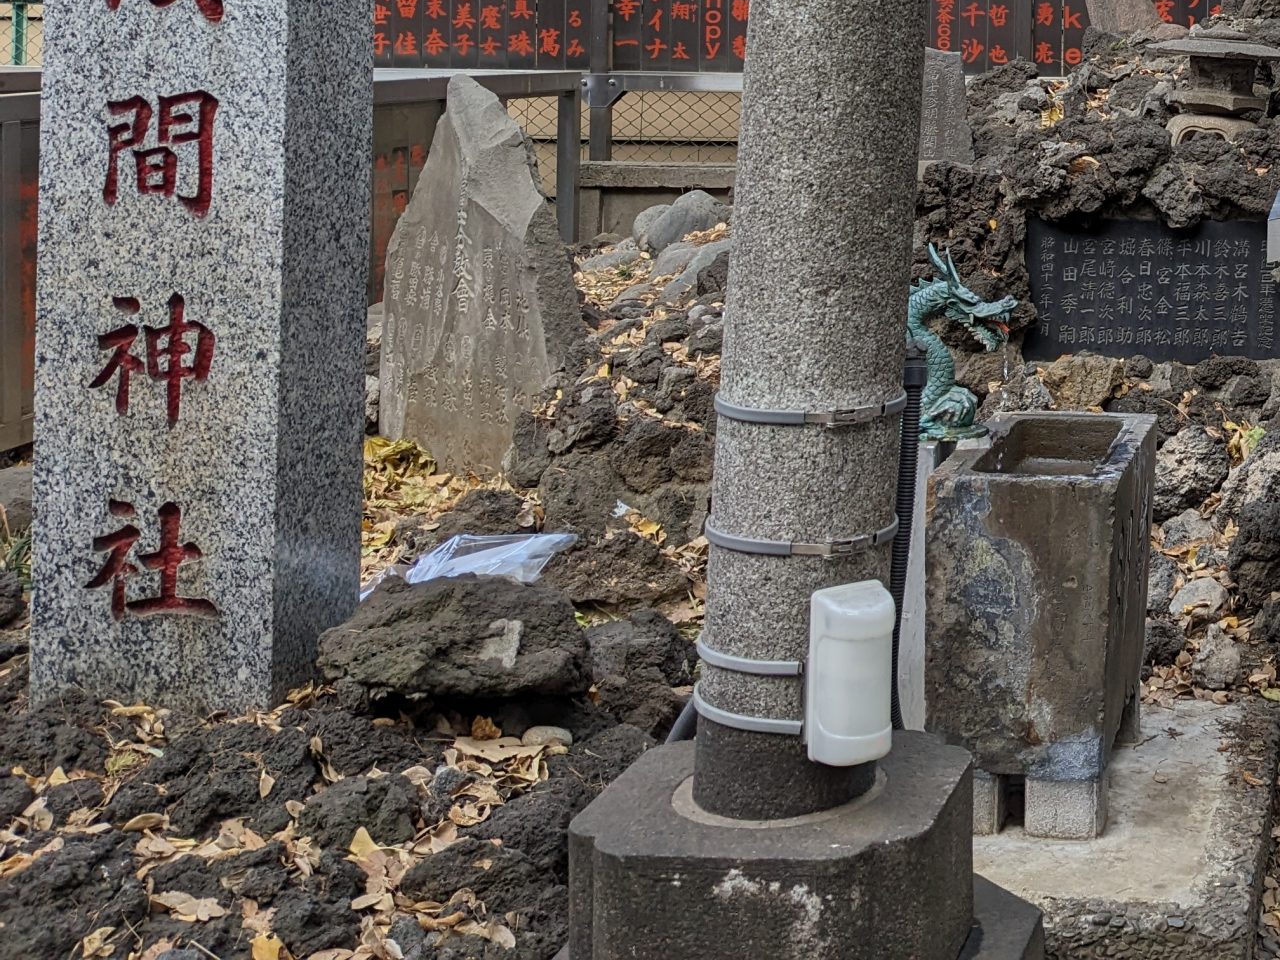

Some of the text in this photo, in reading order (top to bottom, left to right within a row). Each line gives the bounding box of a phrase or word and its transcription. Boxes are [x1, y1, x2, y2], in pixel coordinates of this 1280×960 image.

[1040, 236, 1056, 337] 昭和四十二年七月
[1079, 239, 1097, 345] 宮尾清一郎
[1135, 238, 1155, 346] 春日忠次郎
[1173, 239, 1193, 346] 平本福三郎
[1193, 238, 1213, 346] 川本森太郎
[1211, 238, 1231, 348] 鈴木喜三郎
